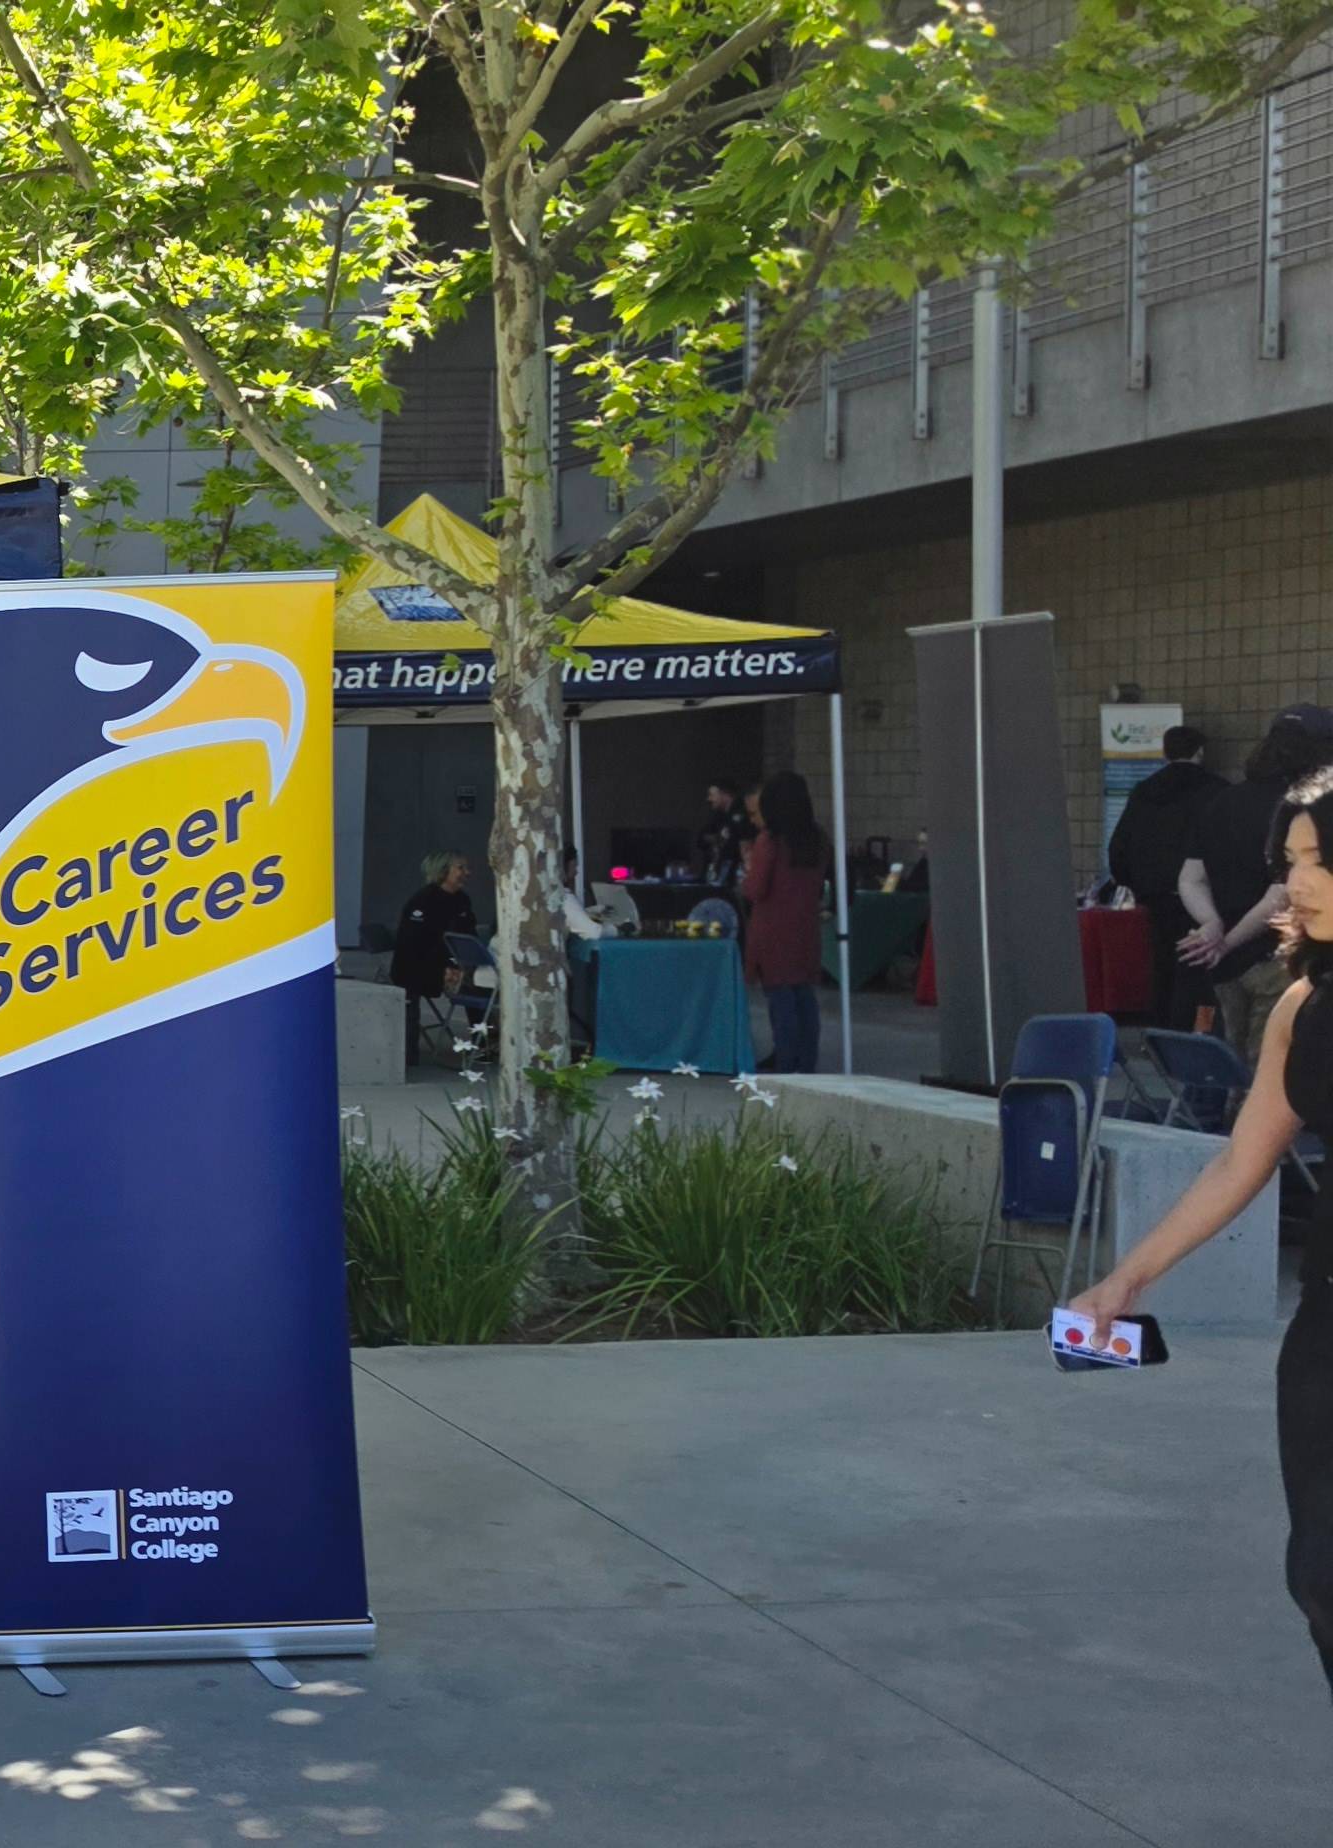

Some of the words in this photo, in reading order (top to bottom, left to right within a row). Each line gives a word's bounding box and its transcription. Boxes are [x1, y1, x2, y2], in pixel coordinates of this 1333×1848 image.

[654, 648, 805, 680] matters.
[0, 790, 255, 927] Career
[129, 1486, 233, 1510] Santiago
[130, 1514, 219, 1537] Canyon
[131, 1539, 218, 1563] College
